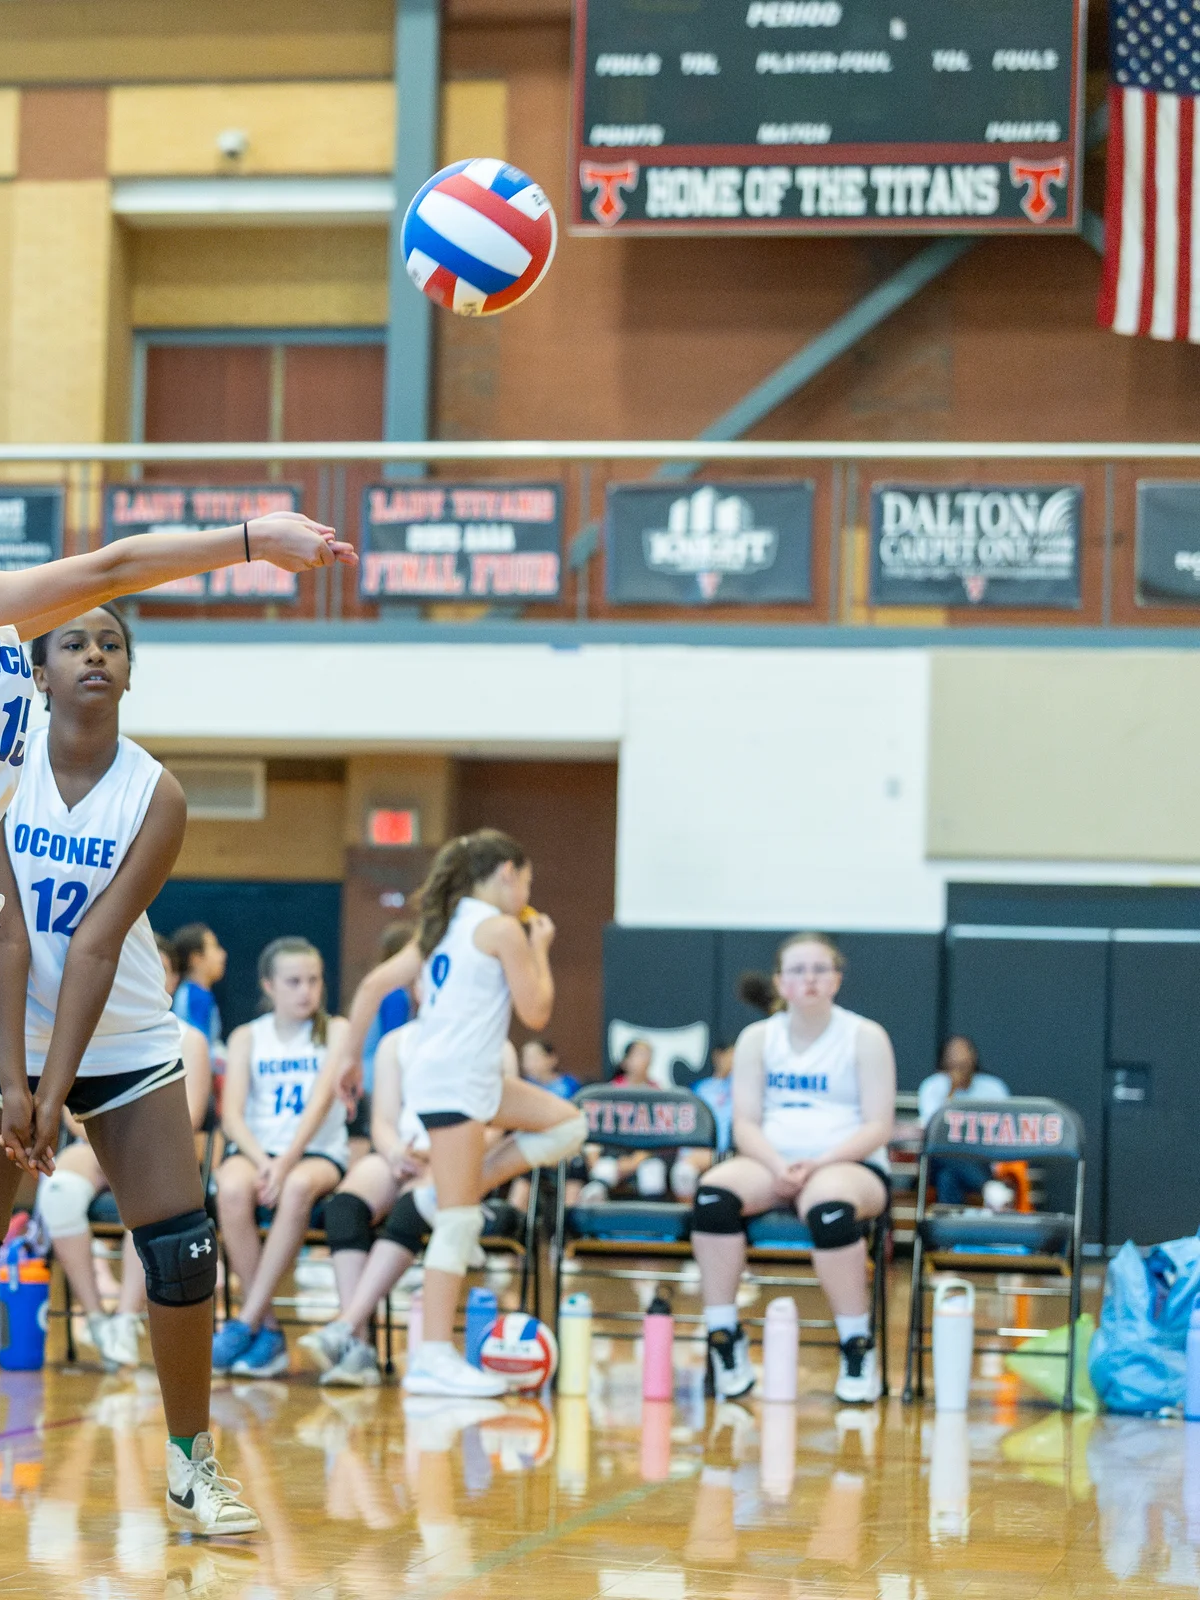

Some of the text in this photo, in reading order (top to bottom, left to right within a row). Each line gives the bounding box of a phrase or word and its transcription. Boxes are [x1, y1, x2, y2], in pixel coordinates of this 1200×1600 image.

[746, 0, 842, 28] PERIOD
[646, 167, 742, 217] HOME
[744, 166, 792, 217] OF
[794, 166, 867, 216] THE
[869, 165, 1000, 216] TITANS
[370, 488, 556, 524] LADY TITANS
[881, 490, 1041, 540] DALTON
[361, 551, 561, 596] FINAL FOUR
[14, 823, 116, 869] OCONEE
[31, 877, 89, 937] 12
[274, 1084, 305, 1116] 14
[583, 1100, 697, 1135] TITANS
[944, 1110, 1064, 1146] TITANS
